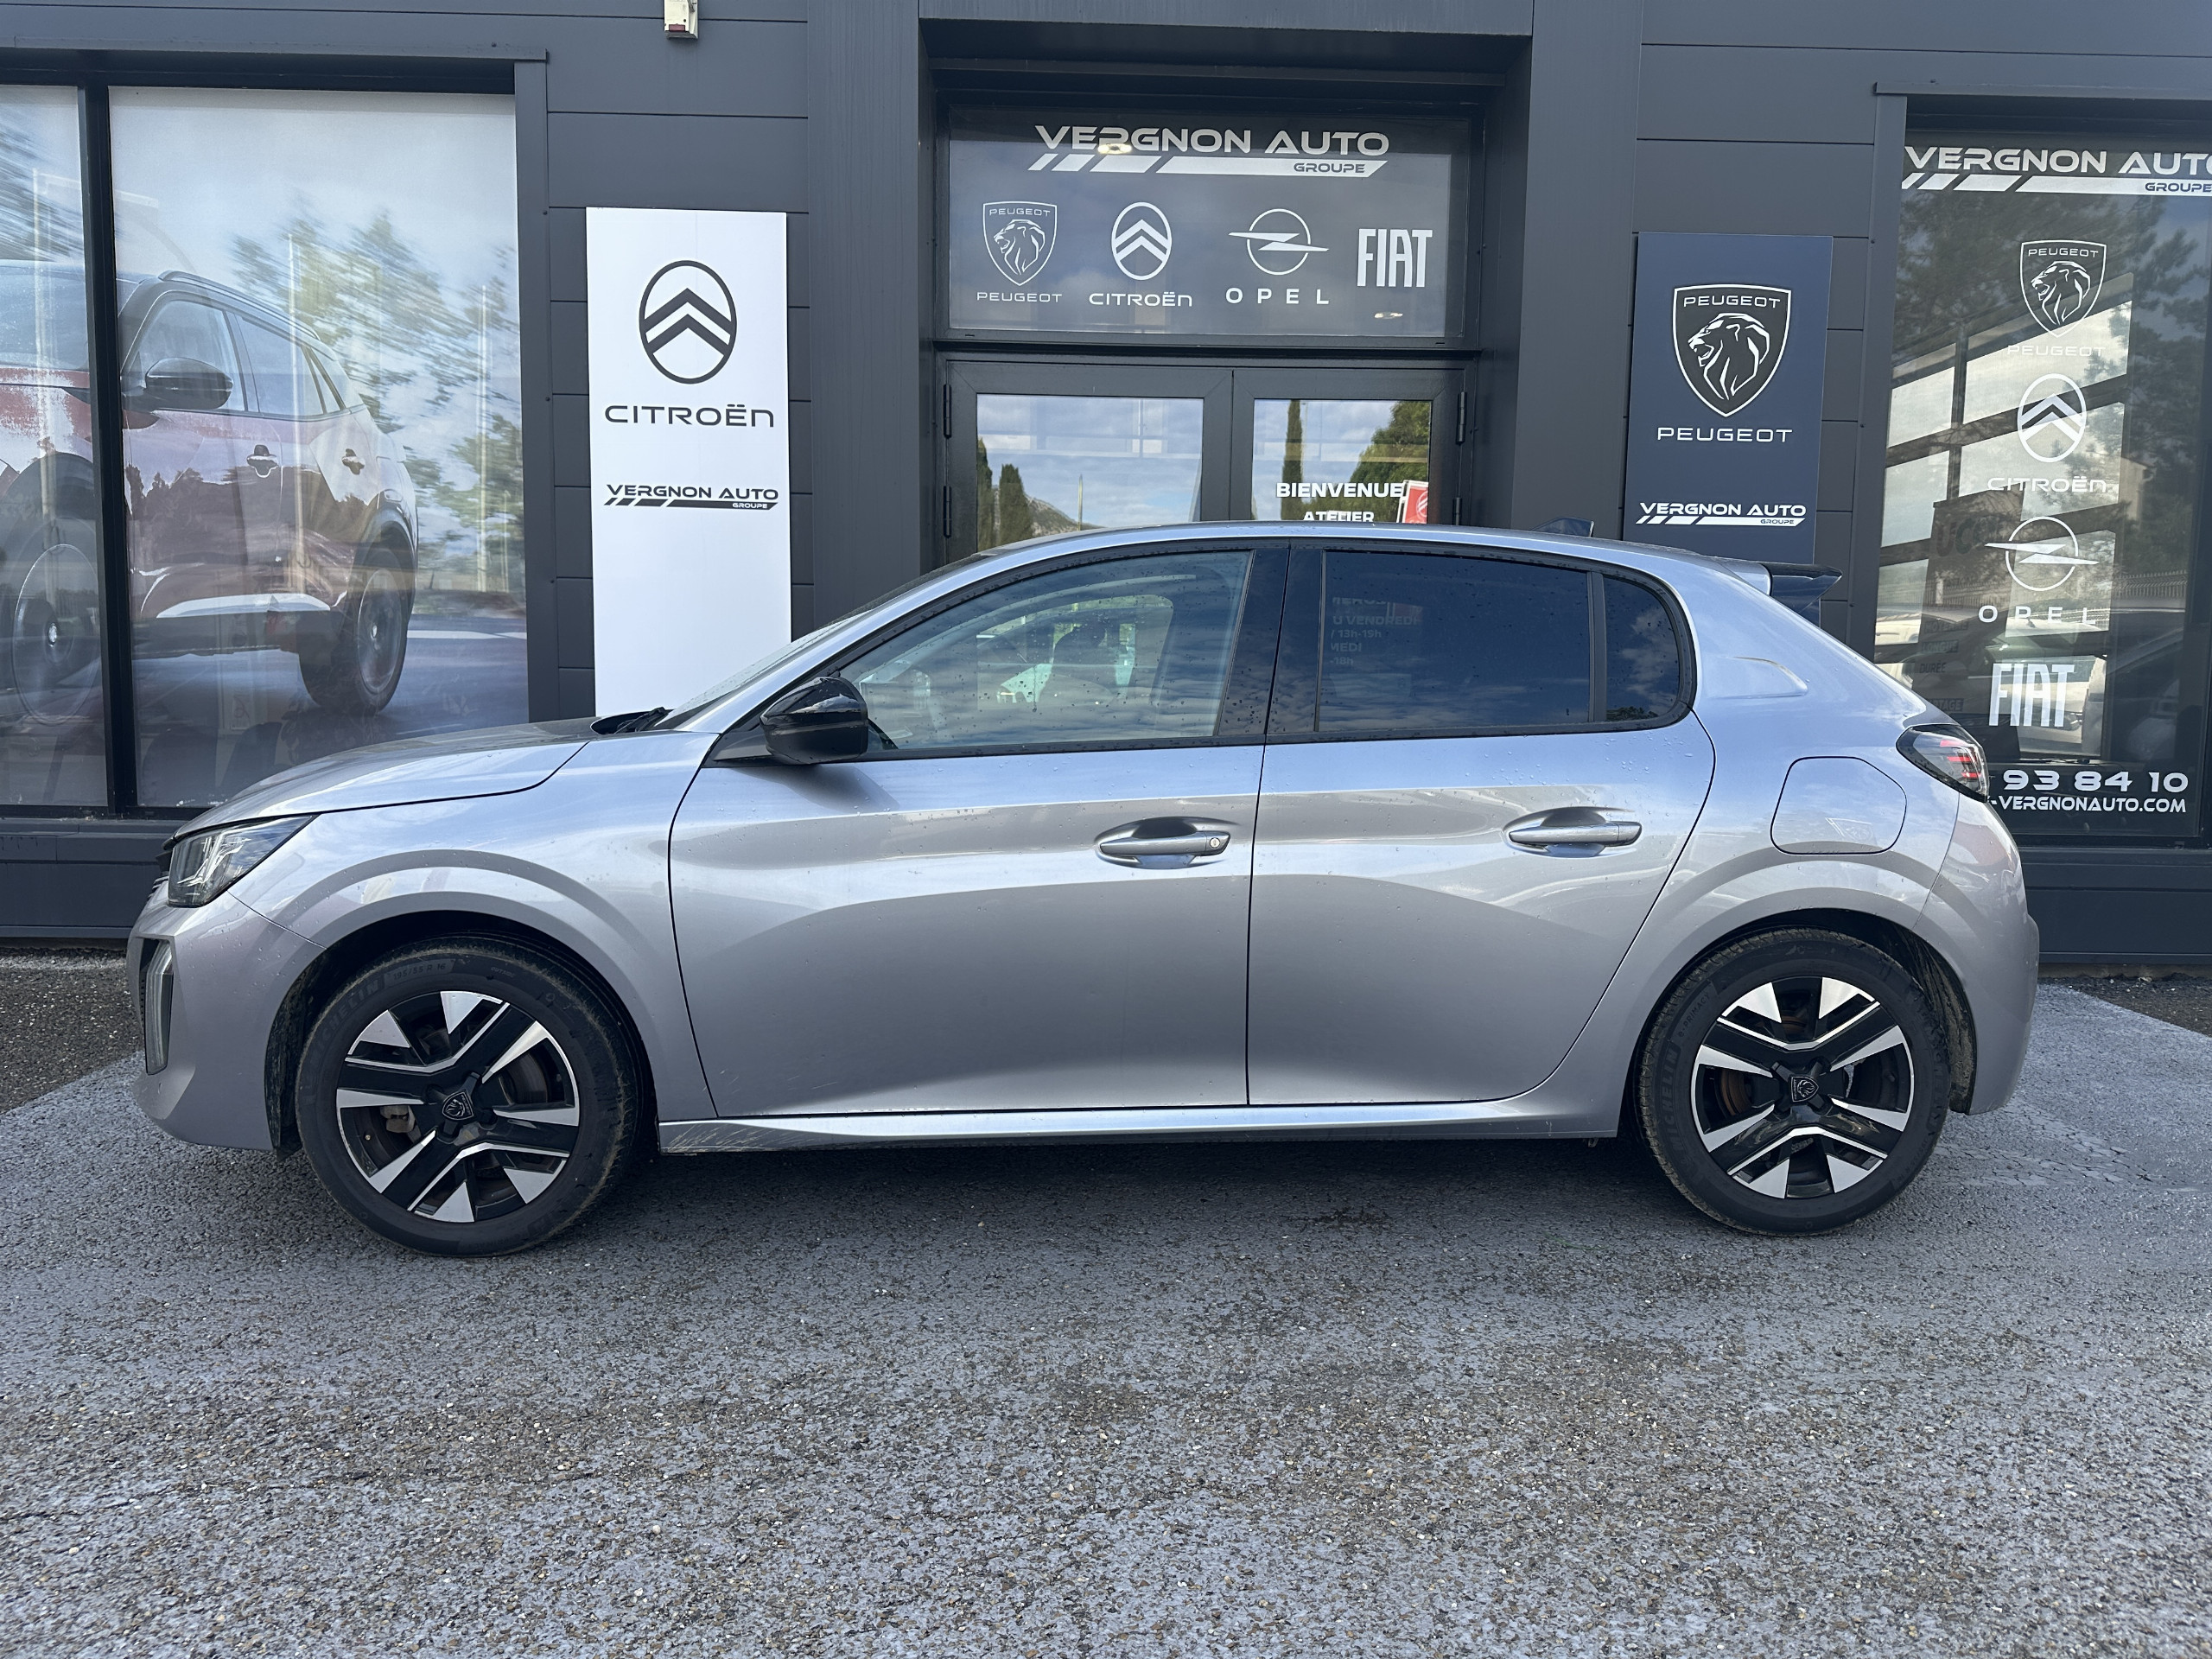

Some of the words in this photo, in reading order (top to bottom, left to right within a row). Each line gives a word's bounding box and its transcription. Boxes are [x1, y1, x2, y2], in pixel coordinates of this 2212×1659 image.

[1035, 125, 1251, 153] VERGNON
[1264, 130, 1389, 156] AUTO
[1294, 162, 1366, 174] GROUPE
[1904, 146, 2107, 173] VERGNON
[2118, 151, 2212, 175] AUT
[2145, 182, 2212, 193] GROUPE
[988, 207, 1052, 218] PEUGEOT
[1357, 228, 1433, 288] FIAT
[2028, 246, 2099, 258] PEUGEOT
[976, 291, 1063, 303] PEUGEOT
[1225, 288, 1330, 305] OPEL
[1683, 295, 1781, 308] PEUGEOT
[2006, 345, 2107, 357] PEUGEOT
[1657, 427, 1793, 442] PEUGEOT
[607, 484, 712, 499] VERGNON
[718, 487, 779, 500] AUTO
[1276, 482, 1403, 498] BIENVENUE
[1302, 511, 1376, 523] ATELIER
[1640, 502, 1742, 517] VERGNON
[1746, 503, 1807, 517] AUTO
[1988, 662, 2076, 728] FIAT
[1989, 795, 2187, 814] -VERGNONAUTO.COM
